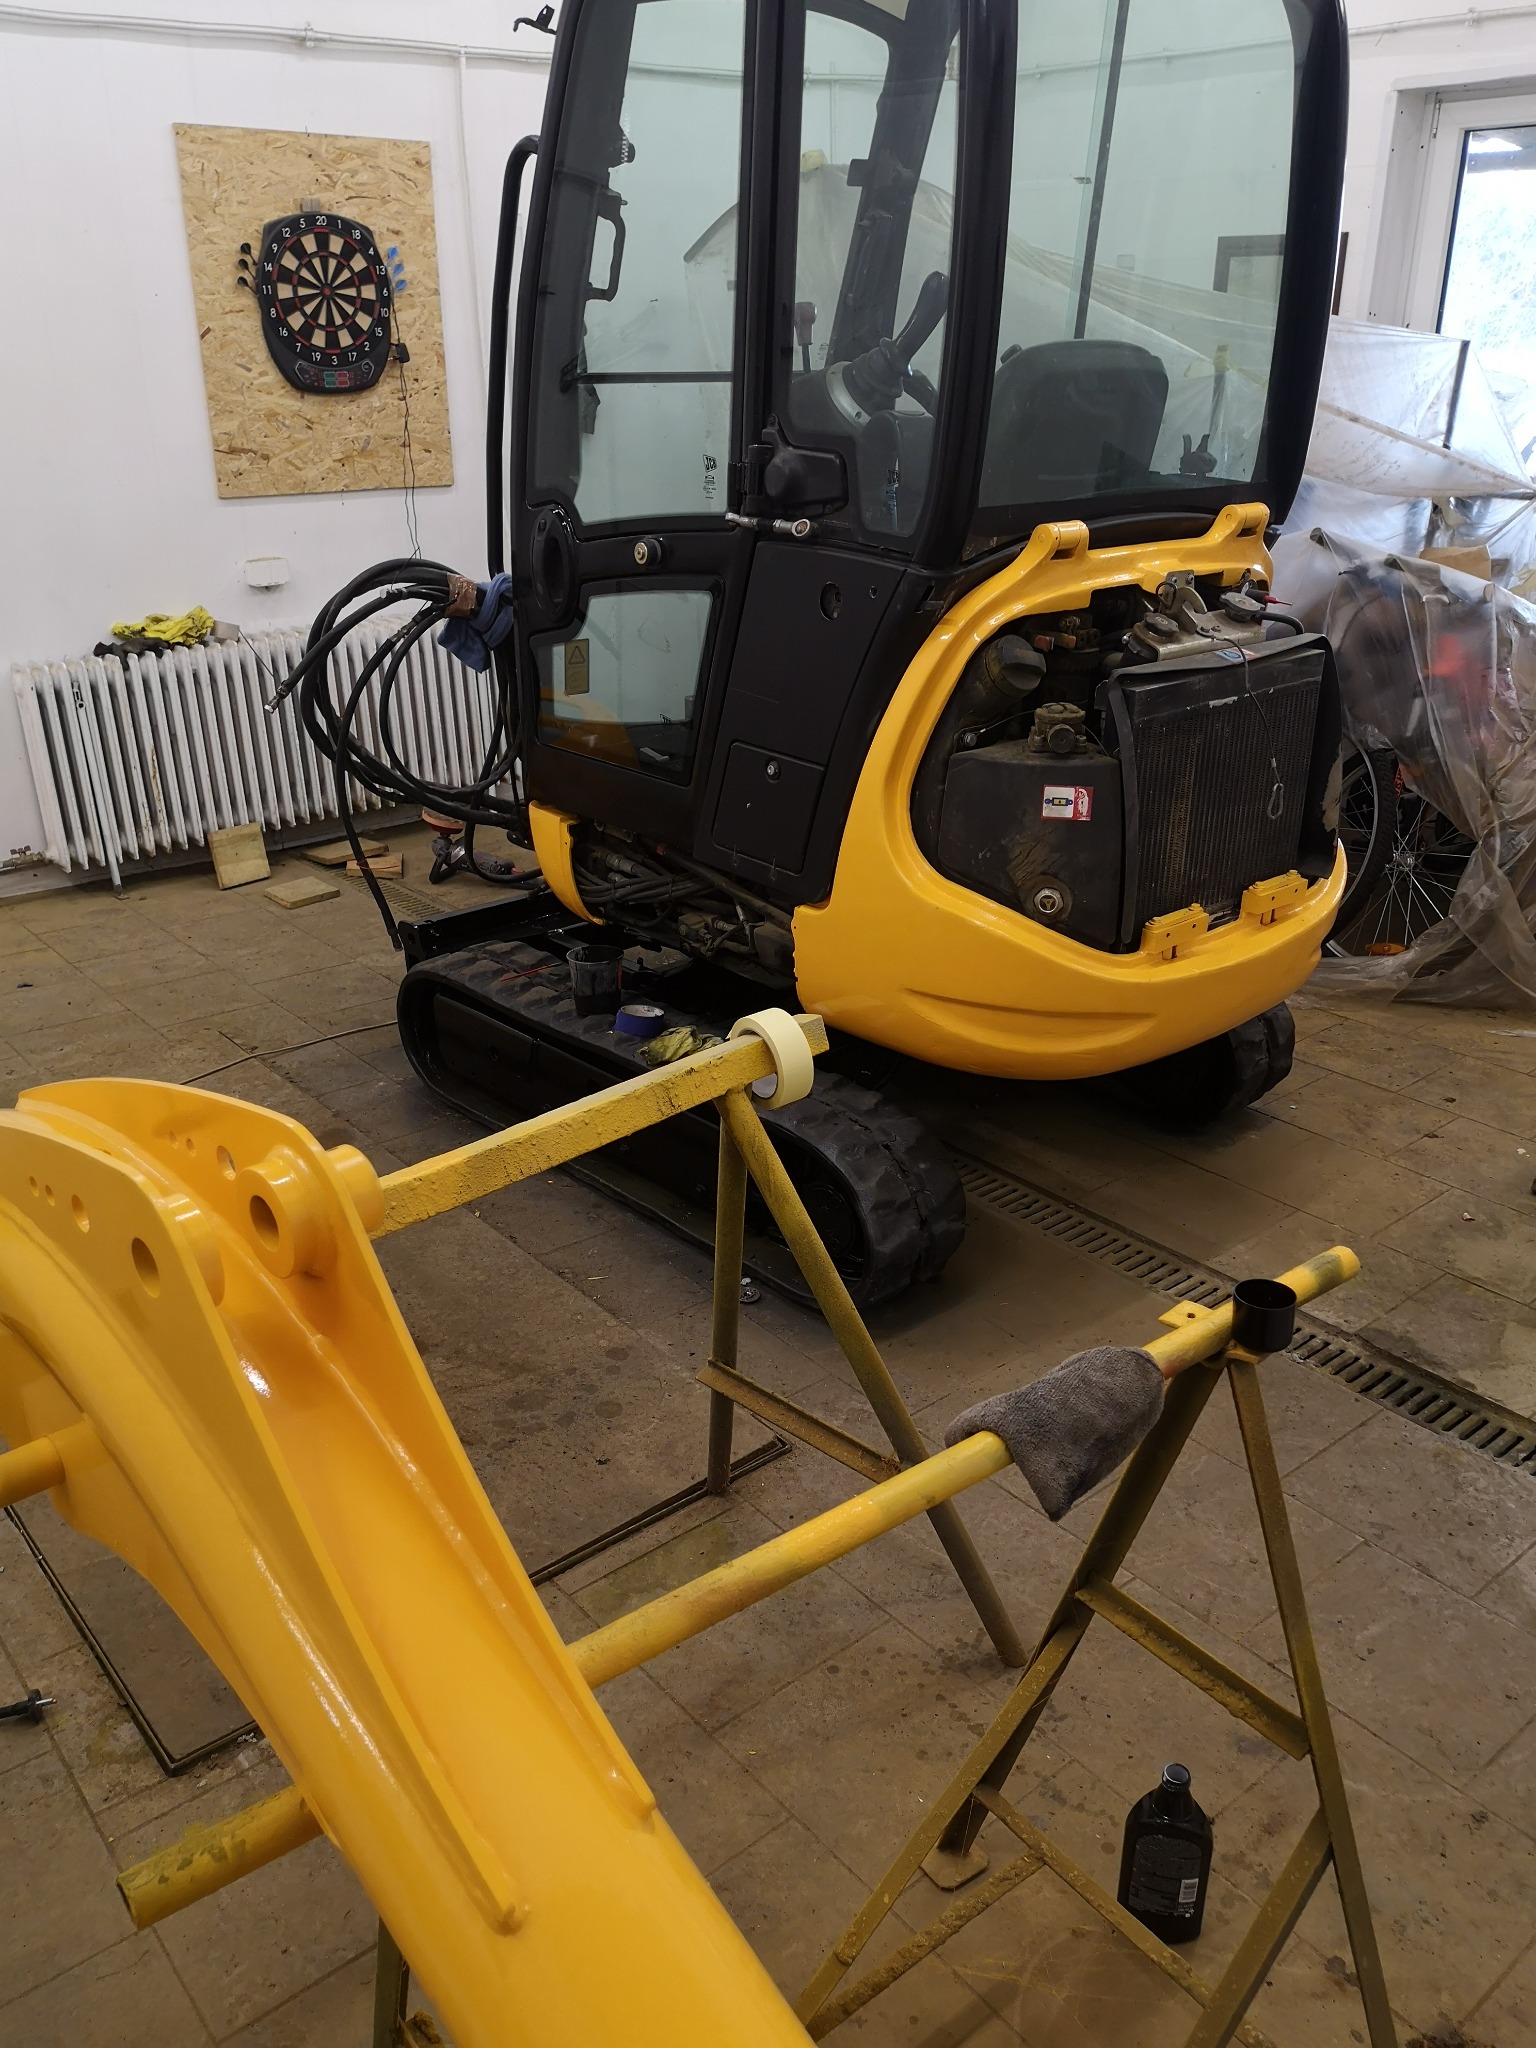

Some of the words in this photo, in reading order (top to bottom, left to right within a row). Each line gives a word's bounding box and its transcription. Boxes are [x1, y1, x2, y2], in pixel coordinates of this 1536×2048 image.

[300, 218, 306, 228] 5
[316, 216, 328, 226] 20
[338, 220, 342, 228] 1
[282, 228, 290, 238] 12
[352, 230, 362, 240] 18
[272, 244, 278, 254] 9
[368, 246, 374, 256] 4
[264, 262, 272, 272] 14
[376, 264, 386, 274] 13
[262, 284, 272, 294] 11
[382, 288, 388, 296] 6
[270, 308, 276, 318] 8
[380, 308, 390, 318] 10
[278, 326, 288, 336] 16
[374, 328, 382, 336] 15
[296, 342, 302, 352] 7
[364, 342, 370, 350] 2
[312, 352, 320, 362] 19
[332, 356, 338, 364] 3
[348, 352, 356, 362] 17
[704, 456, 717, 471] JCB
